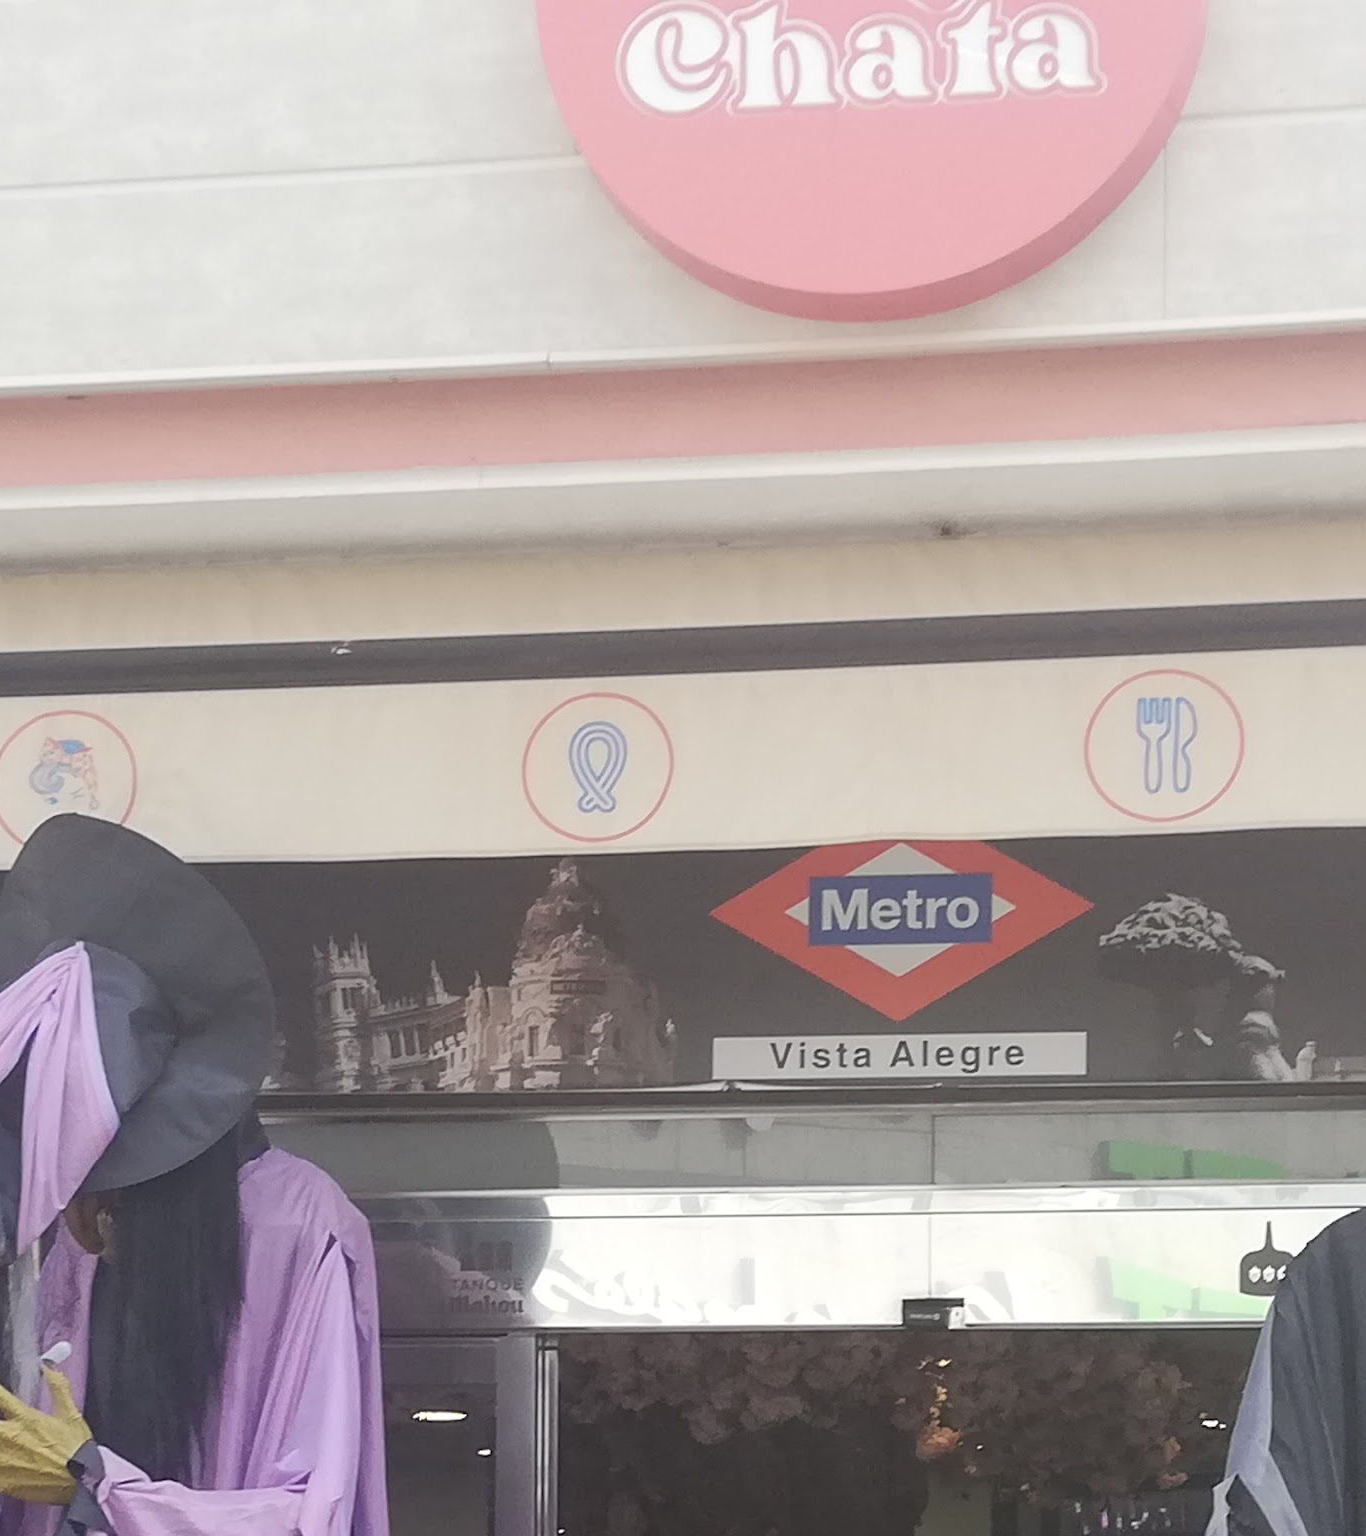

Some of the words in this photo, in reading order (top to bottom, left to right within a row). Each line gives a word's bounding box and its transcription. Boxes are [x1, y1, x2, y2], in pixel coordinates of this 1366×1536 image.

[617, 0, 1106, 116] Chata
[821, 888, 980, 931] Metro
[770, 1041, 872, 1070] Vista
[890, 1039, 1026, 1074] Alegre
